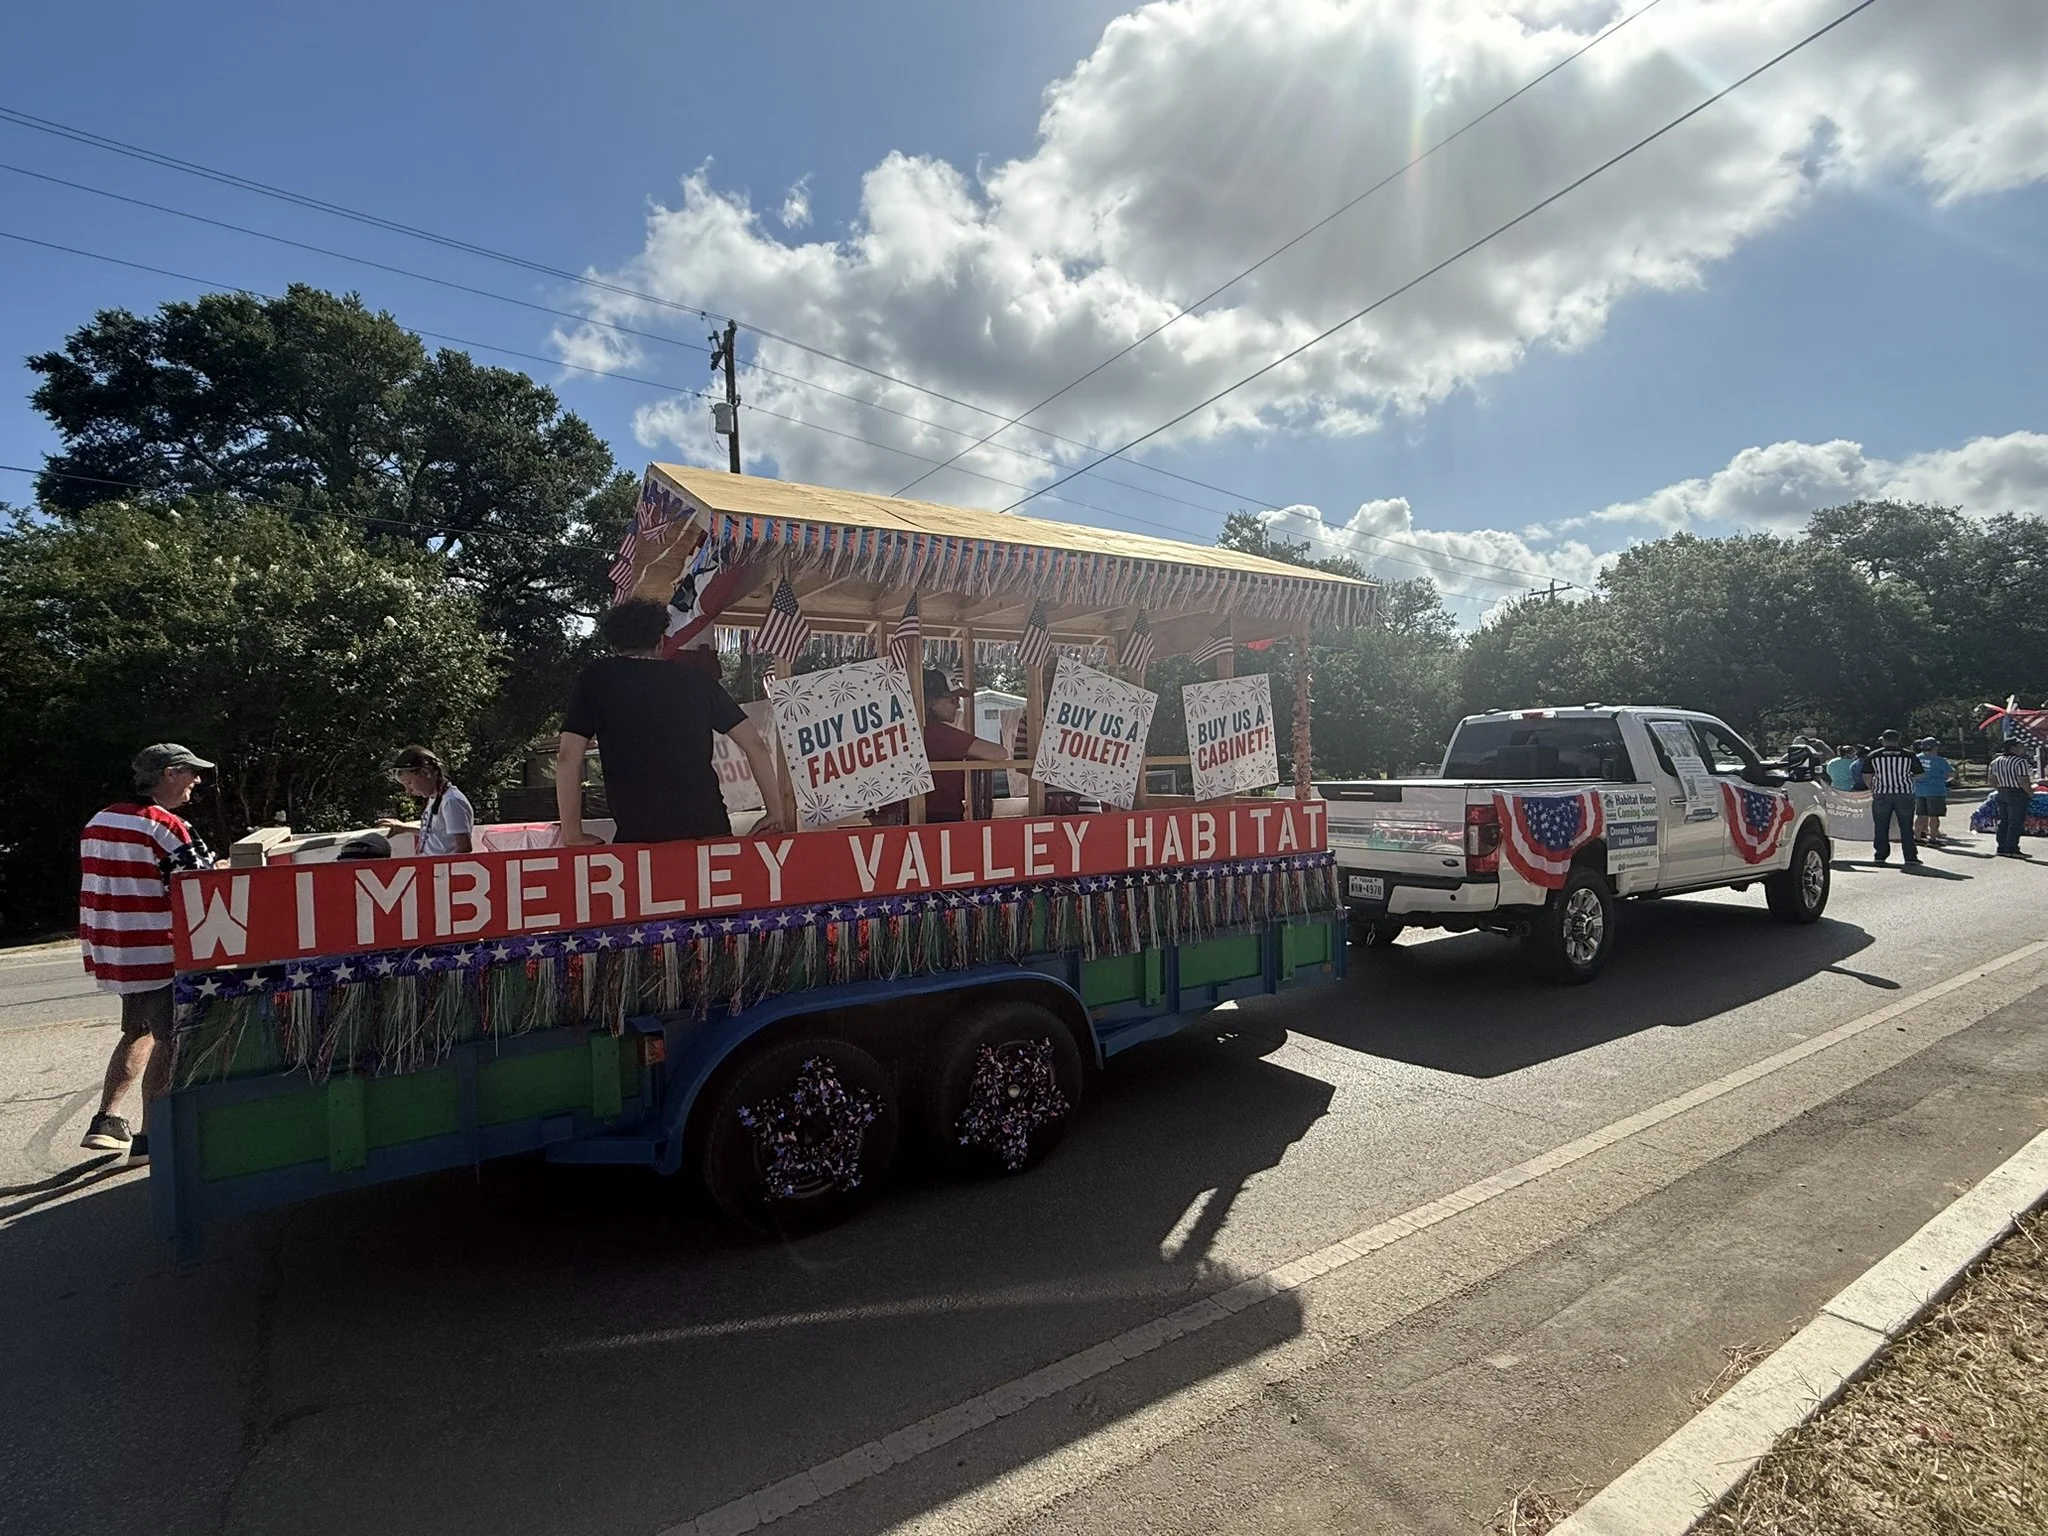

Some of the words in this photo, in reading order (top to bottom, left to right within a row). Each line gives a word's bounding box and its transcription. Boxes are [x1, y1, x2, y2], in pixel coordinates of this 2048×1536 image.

[798, 713, 844, 757] BUY
[852, 701, 884, 735] US
[890, 694, 905, 723] A
[1056, 701, 1098, 732] BUY
[1099, 712, 1124, 739] US
[1125, 720, 1139, 743] A
[1197, 715, 1227, 746] BUY
[1232, 708, 1251, 733] US
[1255, 704, 1265, 727] A
[807, 722, 909, 789] FAUCET!
[1057, 727, 1131, 768] TOILET!
[1197, 725, 1269, 772] CABINET!
[1614, 793, 1638, 806] Habitat
[1639, 793, 1657, 805] Home
[1617, 806, 1640, 820] Coming
[181, 838, 794, 960] WIMBERLEY
[848, 820, 1091, 893] VALLEY
[1127, 805, 1323, 868] HABITAT
